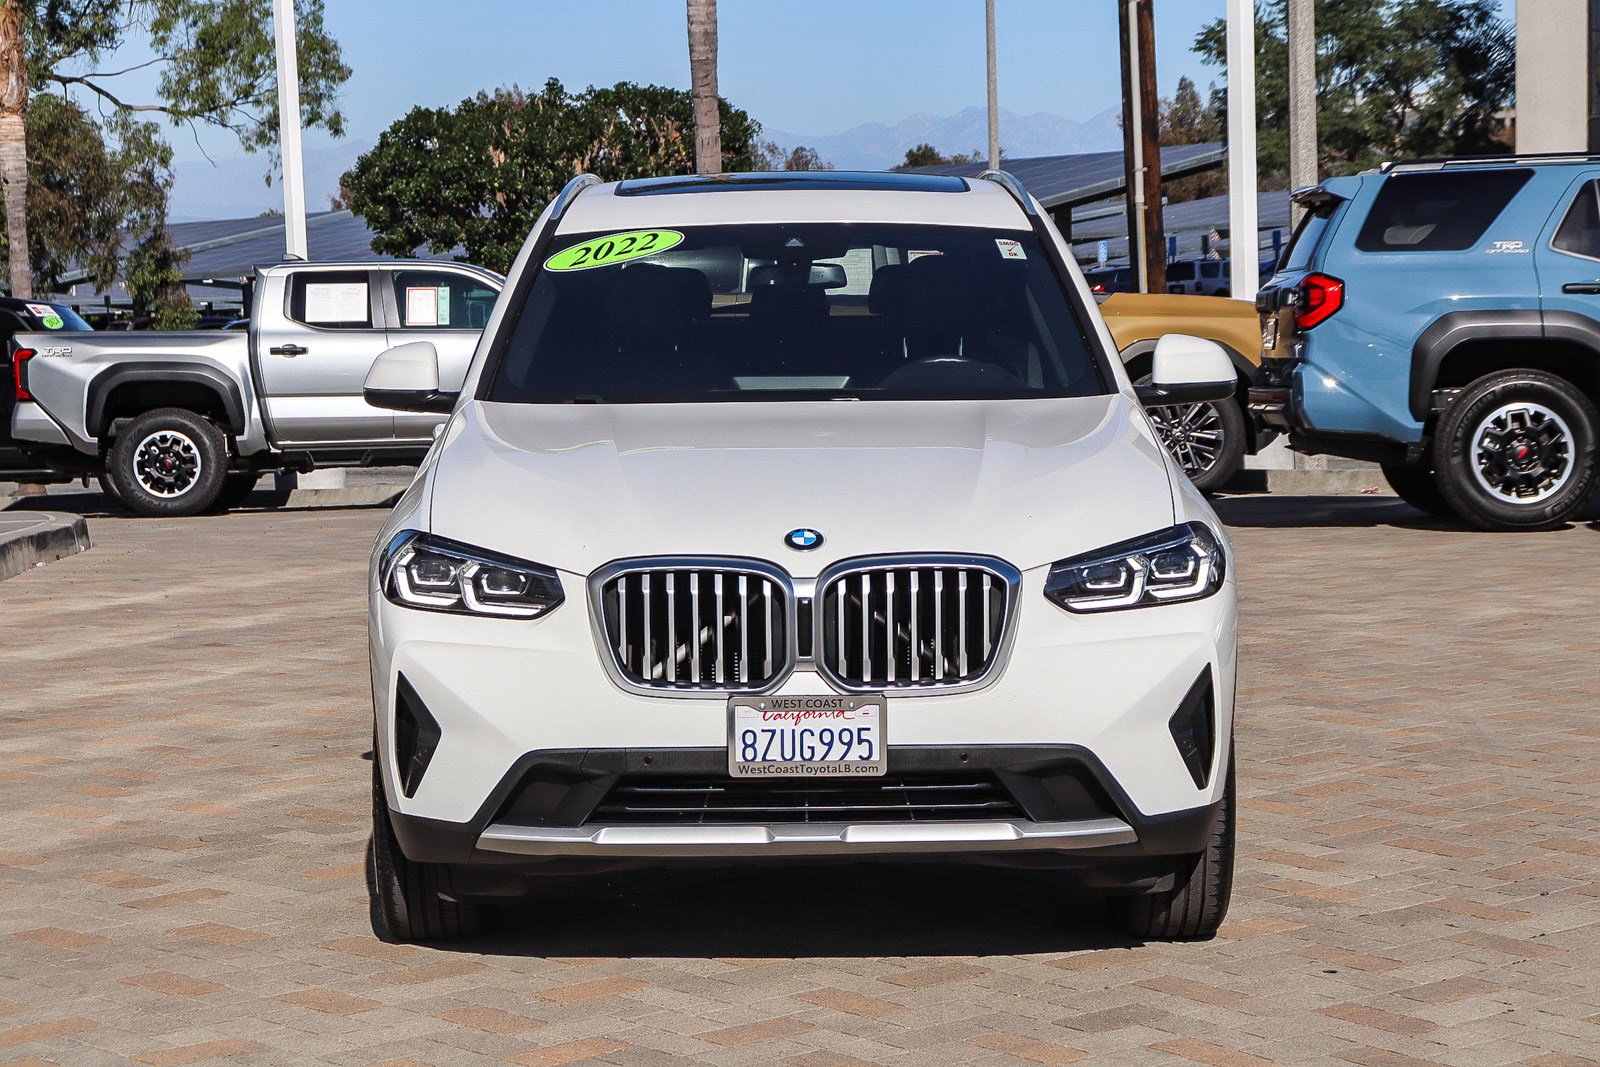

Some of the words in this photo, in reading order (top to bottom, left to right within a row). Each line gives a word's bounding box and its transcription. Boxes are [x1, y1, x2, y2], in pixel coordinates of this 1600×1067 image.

[569, 233, 660, 267] 2022
[1492, 241, 1523, 249] TRD
[43, 346, 73, 356] TRD
[771, 699, 801, 709] WEST
[805, 698, 844, 709] COAST
[762, 710, 855, 726] California
[741, 727, 873, 762] 8ZUG995
[738, 764, 879, 775] WestCoastToyotaLB.com
